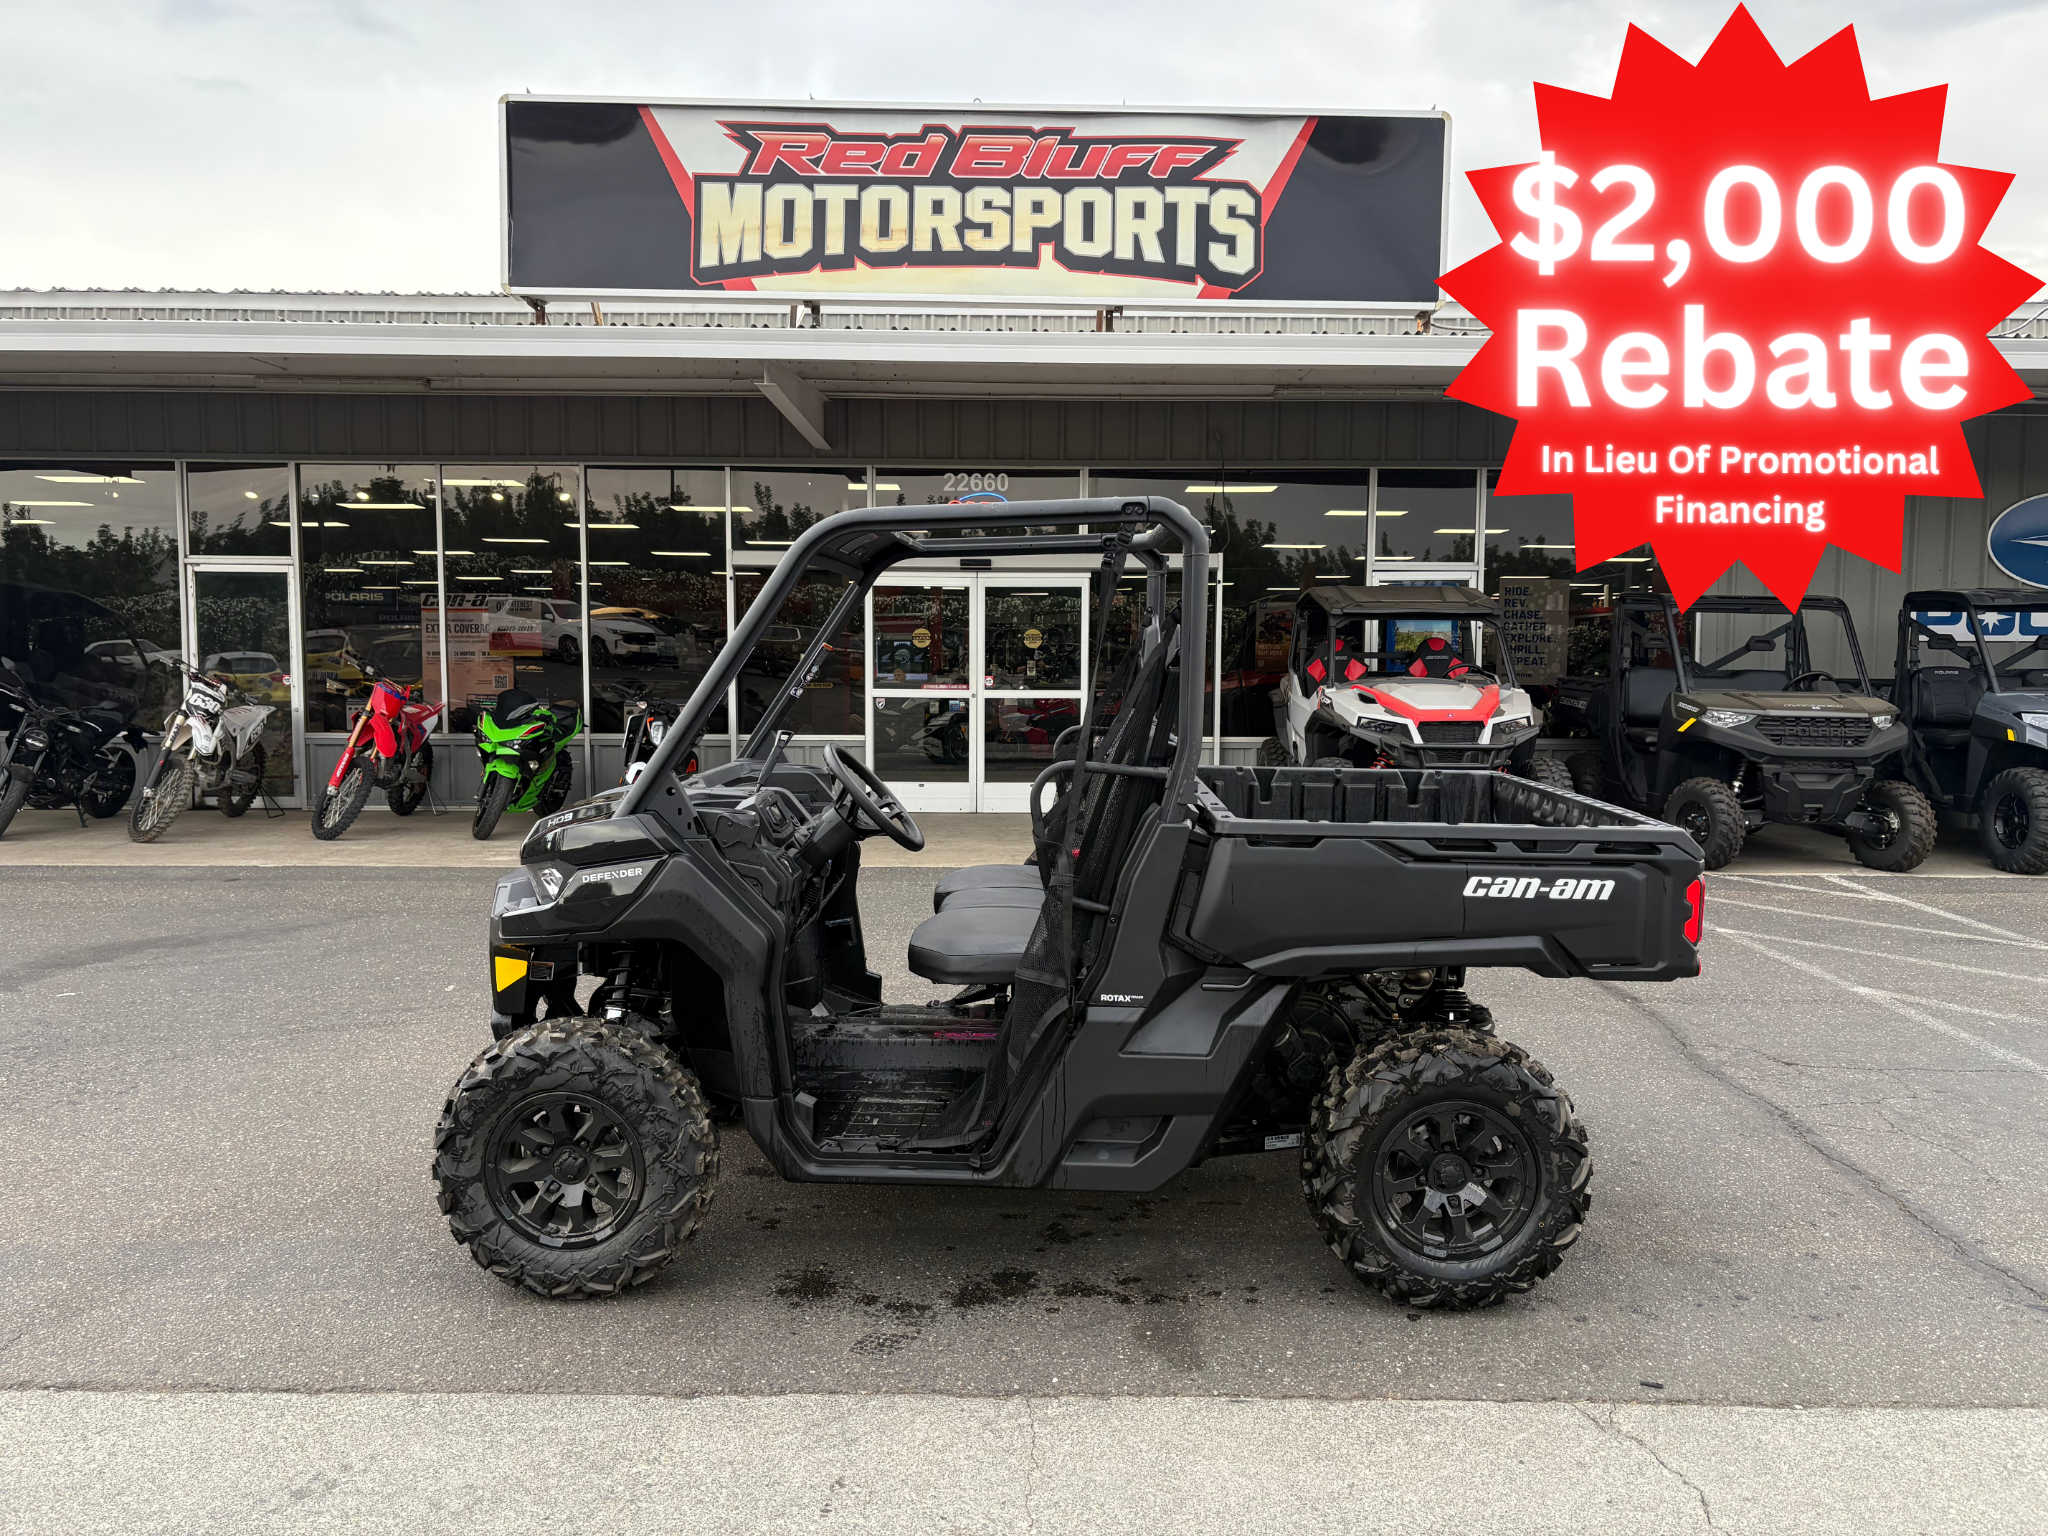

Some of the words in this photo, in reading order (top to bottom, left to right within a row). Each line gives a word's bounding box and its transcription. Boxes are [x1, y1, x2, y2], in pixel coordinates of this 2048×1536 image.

[747, 130, 948, 178] Red
[948, 135, 1217, 179] Bluff
[699, 182, 1257, 276] MOTORSPORTS
[943, 472, 1009, 492] 22660
[1504, 586, 1533, 596] RIDE.
[1504, 598, 1529, 608] REV.
[1503, 610, 1544, 620] CHASE.
[425, 623, 452, 634] EXTA
[454, 623, 489, 634] COVERAG
[1510, 645, 1545, 654] HRILL.
[582, 867, 643, 884] DEFENDER
[1462, 876, 1616, 901] can-am
[1101, 994, 1131, 1003] ROTAX
